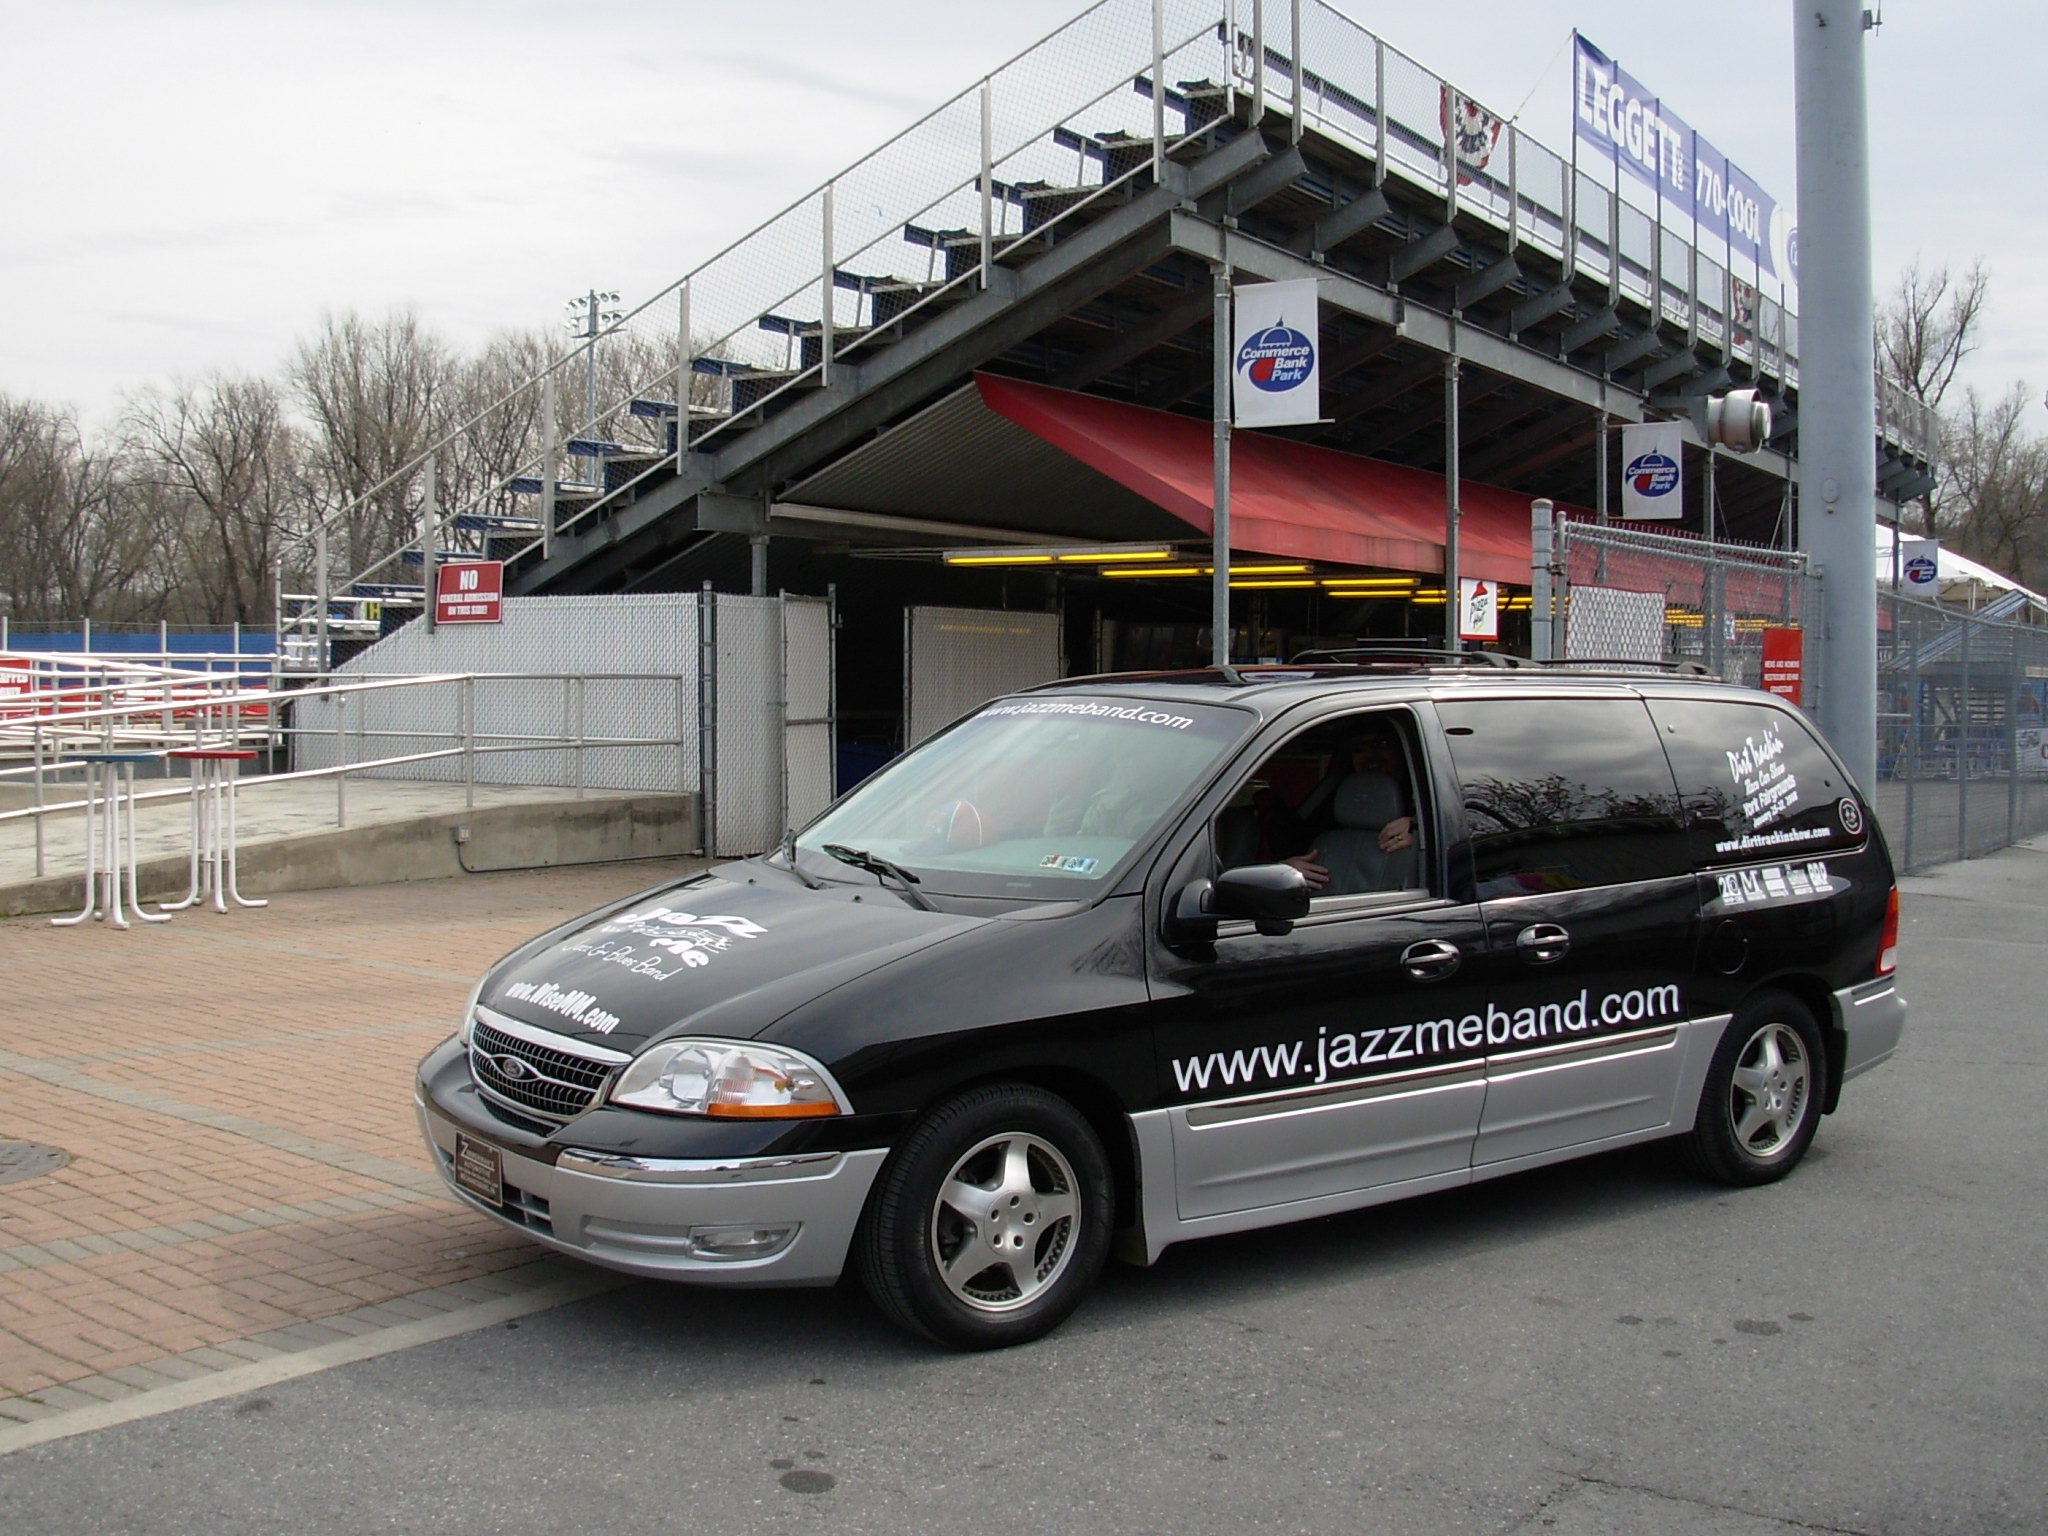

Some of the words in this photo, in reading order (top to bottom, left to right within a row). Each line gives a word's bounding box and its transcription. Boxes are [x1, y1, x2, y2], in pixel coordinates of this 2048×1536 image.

[1578, 54, 1681, 188] LEGGETT
[1696, 158, 1760, 247] 770-COOL
[1241, 345, 1310, 360] Commerce
[1274, 357, 1308, 369] Bank
[1271, 369, 1303, 382] Park
[1628, 466, 1677, 475] Commerce
[1648, 481, 1671, 490] Park
[460, 569, 479, 590] NO
[976, 701, 1194, 730] www.jazzmeband.com
[1726, 746, 1753, 784] Dirt
[1714, 827, 1831, 853] www.dirttrackinshow.com
[603, 945, 638, 966] Blues
[631, 956, 684, 982] Band
[505, 982, 620, 1035] www.WiseMM.com
[1172, 983, 1680, 1092] www.jazzmeband.com
